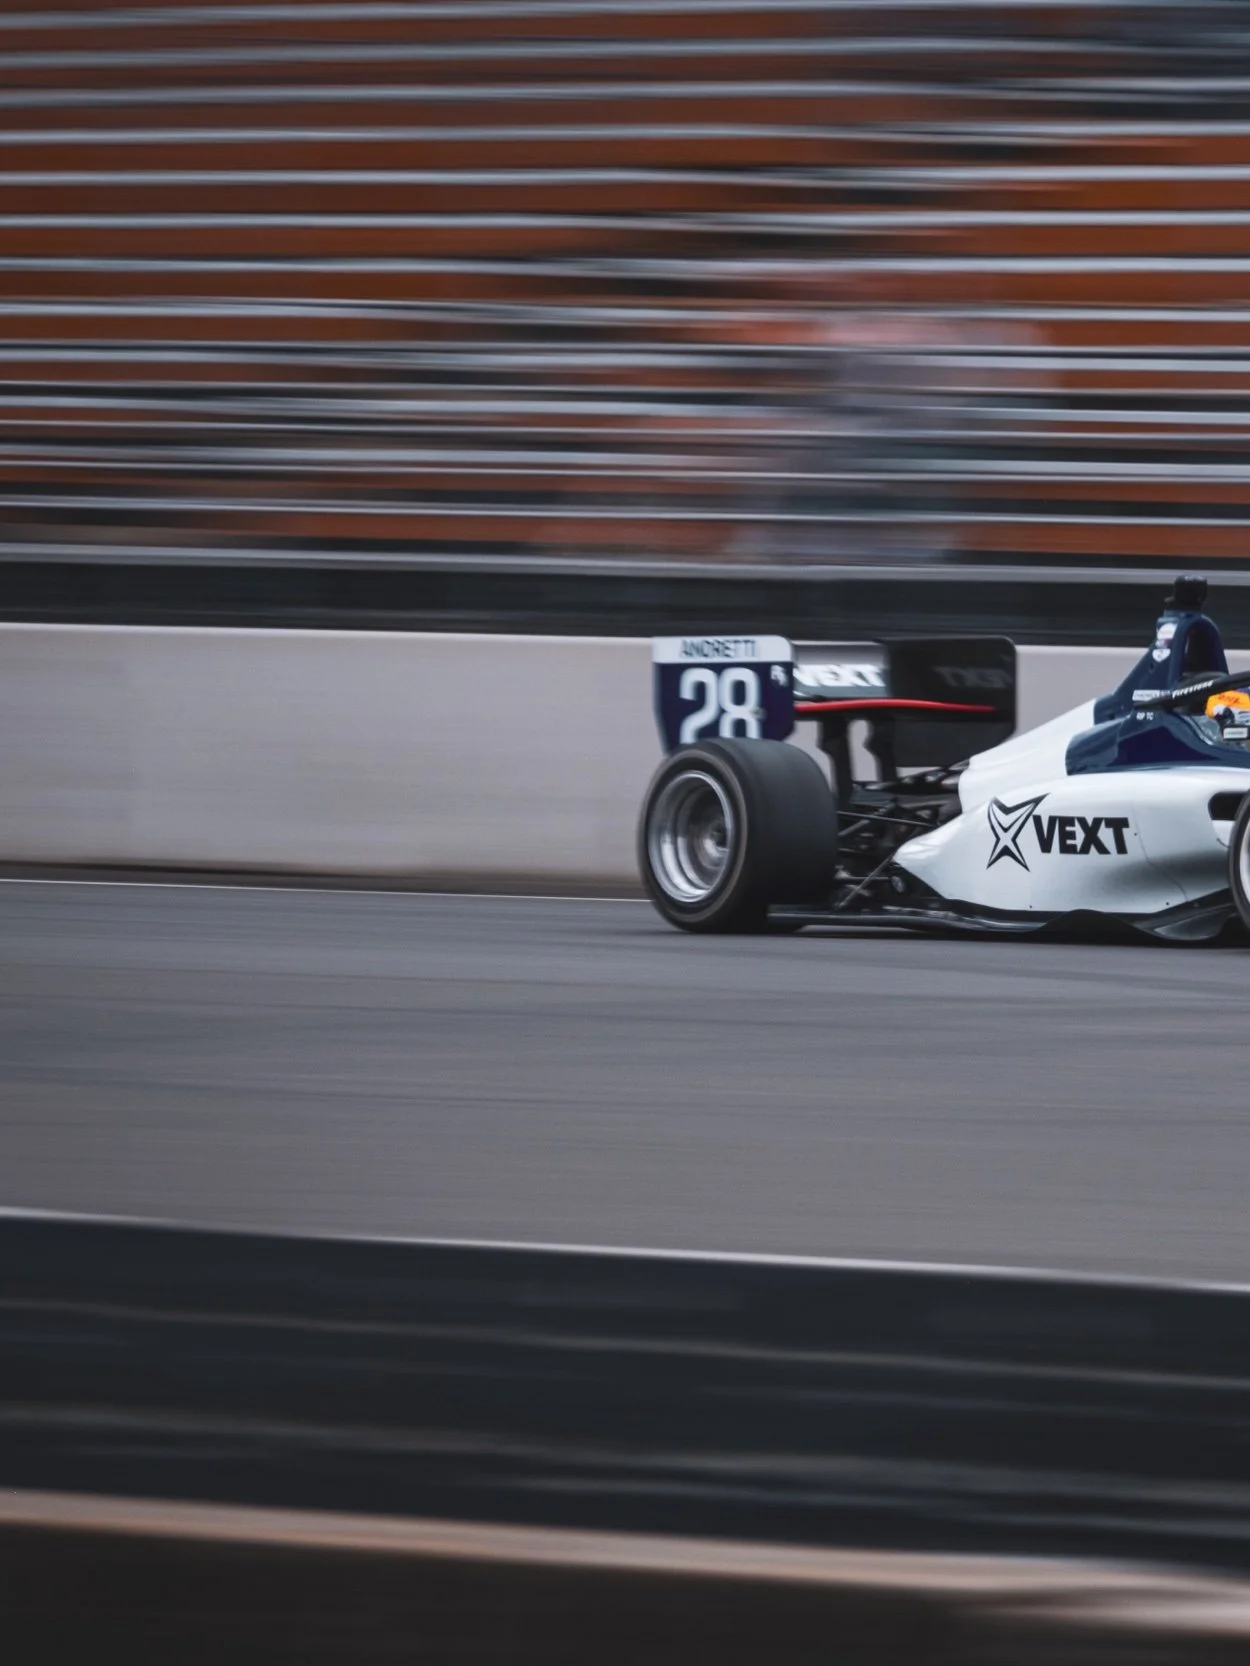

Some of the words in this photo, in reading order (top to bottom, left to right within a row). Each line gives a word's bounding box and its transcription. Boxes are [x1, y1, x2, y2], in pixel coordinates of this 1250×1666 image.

[681, 639, 756, 658] ANDRETTI
[680, 667, 760, 743] 28
[1032, 814, 1130, 855] VEXT
